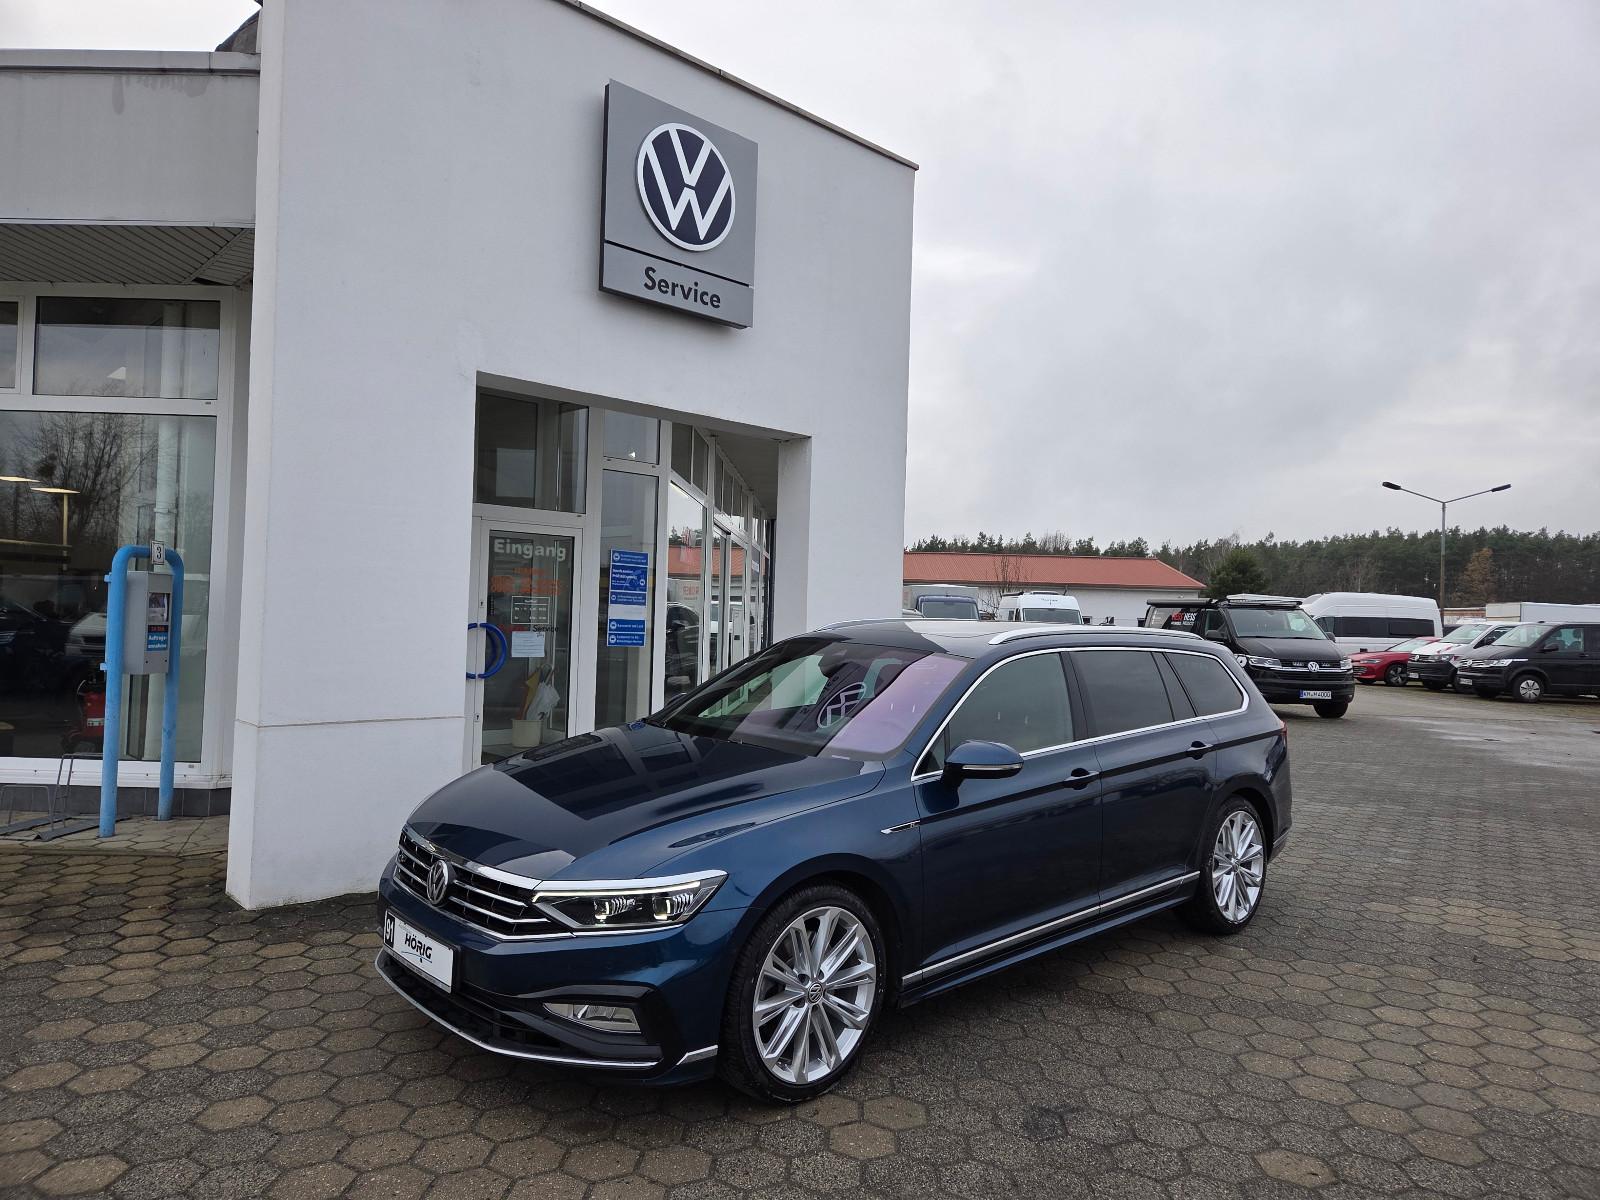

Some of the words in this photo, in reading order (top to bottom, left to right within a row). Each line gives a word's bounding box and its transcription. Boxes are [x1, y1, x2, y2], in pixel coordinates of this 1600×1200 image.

[643, 266, 721, 309] Service
[156, 546, 162, 560] 3
[493, 538, 566, 562] Eingang
[385, 918, 395, 943] 91
[405, 933, 432, 960] HÖRIG
